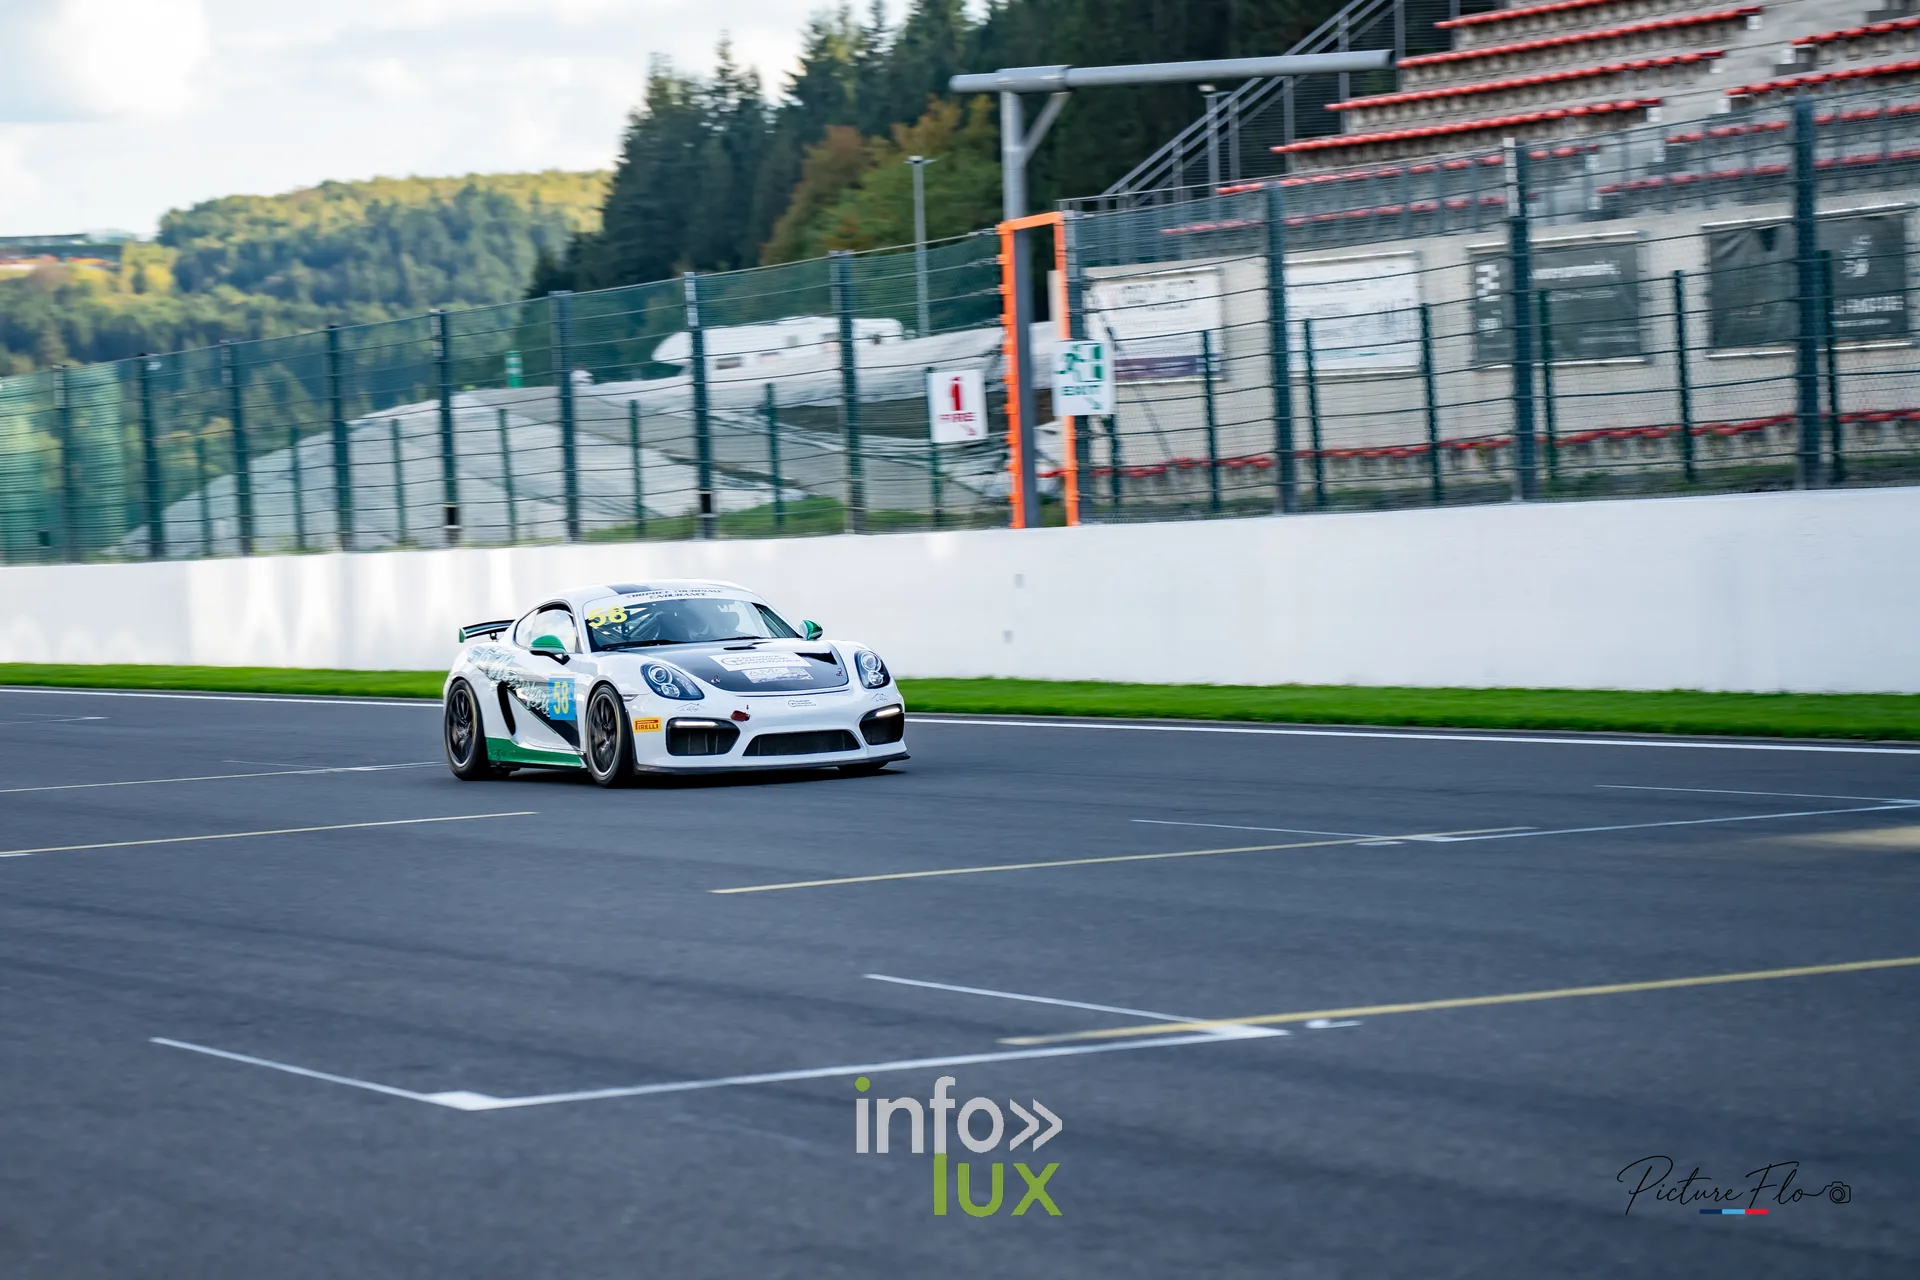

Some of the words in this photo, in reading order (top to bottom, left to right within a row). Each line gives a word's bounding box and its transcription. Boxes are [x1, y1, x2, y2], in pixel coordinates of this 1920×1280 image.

[588, 606, 628, 627] 58
[554, 682, 569, 714] 58
[635, 720, 658, 730] PIRELLI
